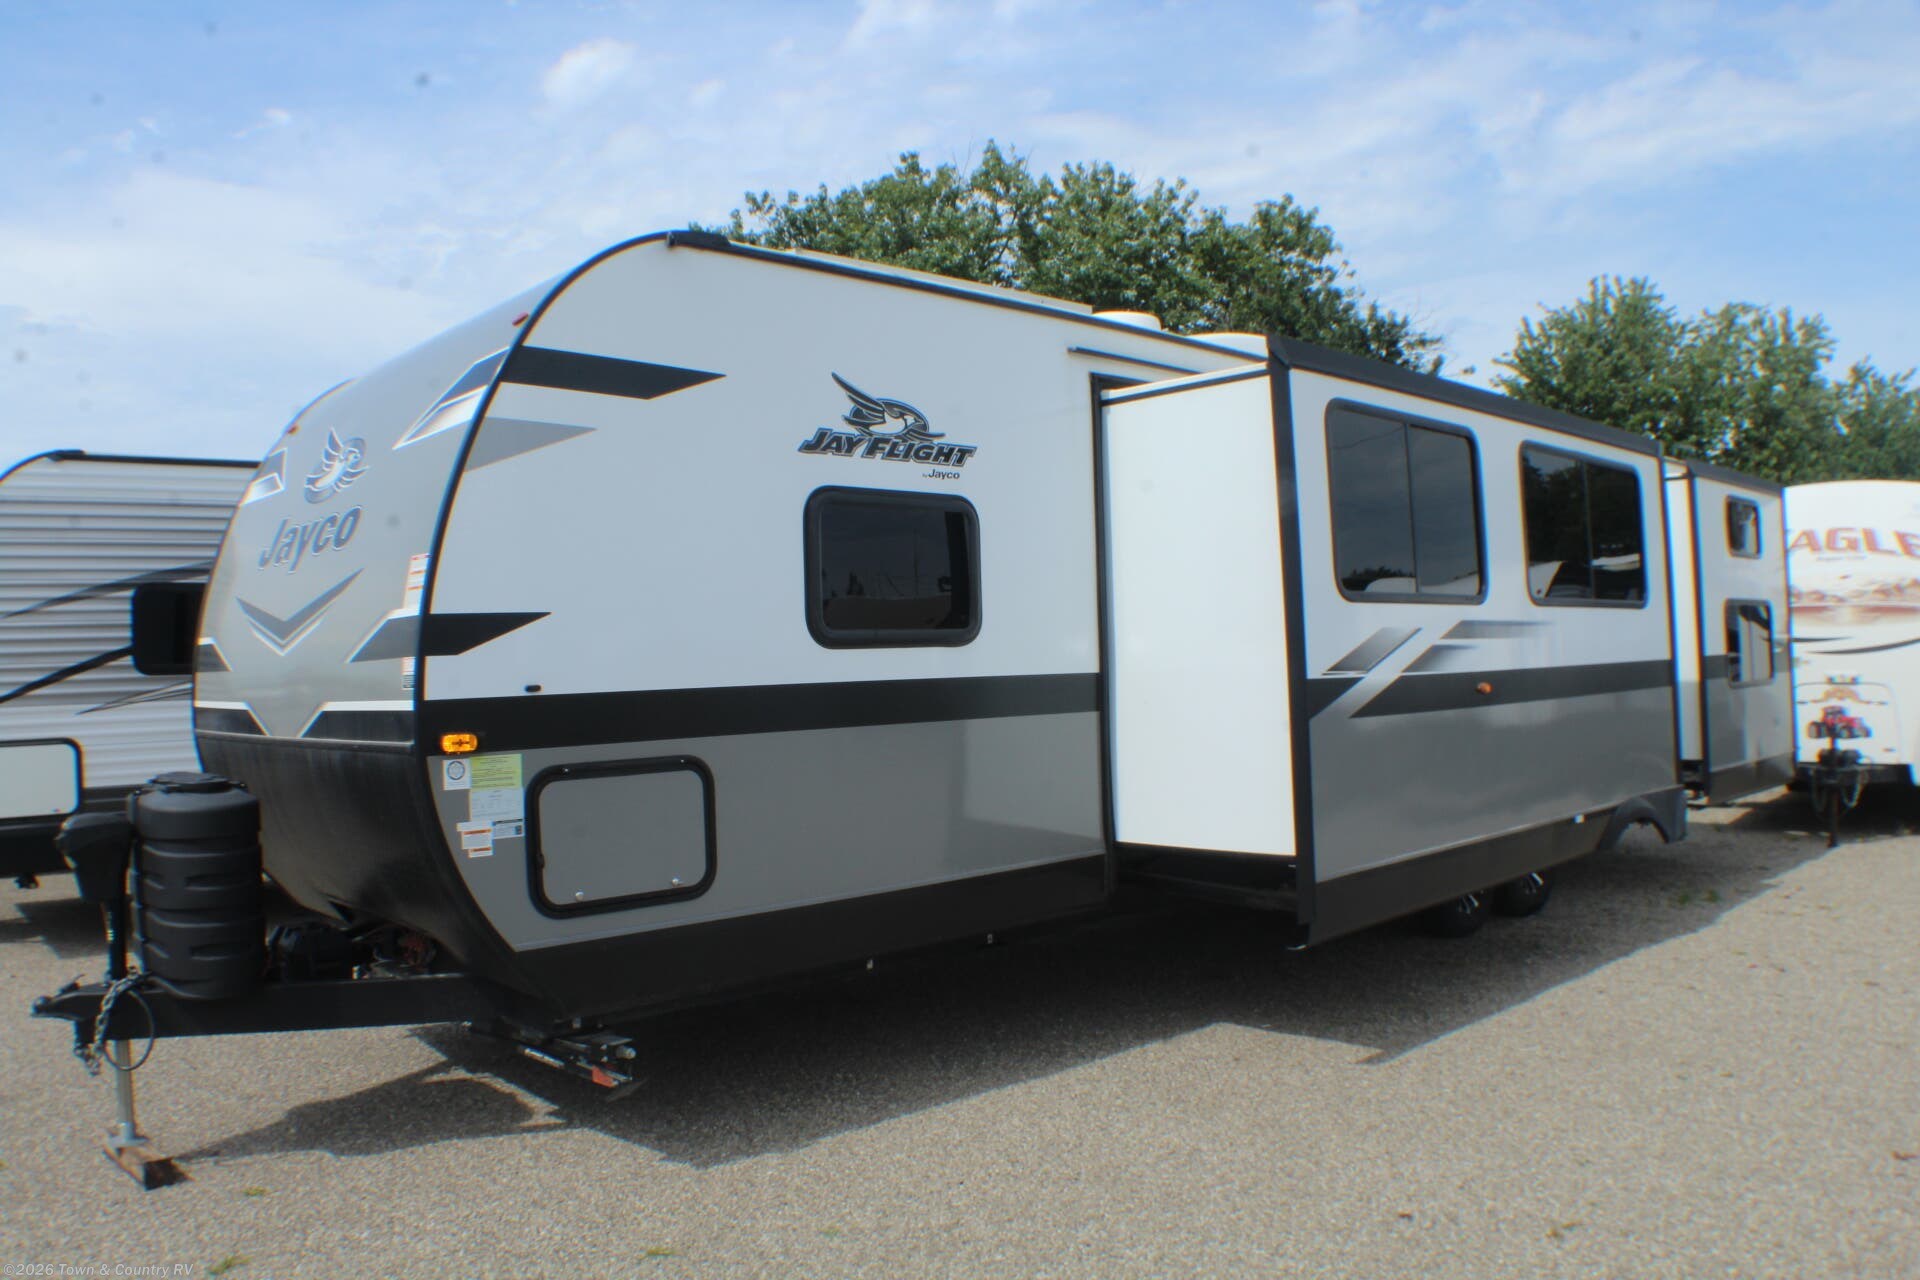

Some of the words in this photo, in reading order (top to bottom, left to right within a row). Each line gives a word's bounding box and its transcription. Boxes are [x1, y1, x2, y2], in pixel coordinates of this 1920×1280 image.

[798, 427, 868, 457] JAY
[861, 435, 977, 467] FLIGHT
[928, 469, 960, 480] Jayco
[258, 505, 363, 575] Jayco
[1785, 527, 1920, 560] AGLE
